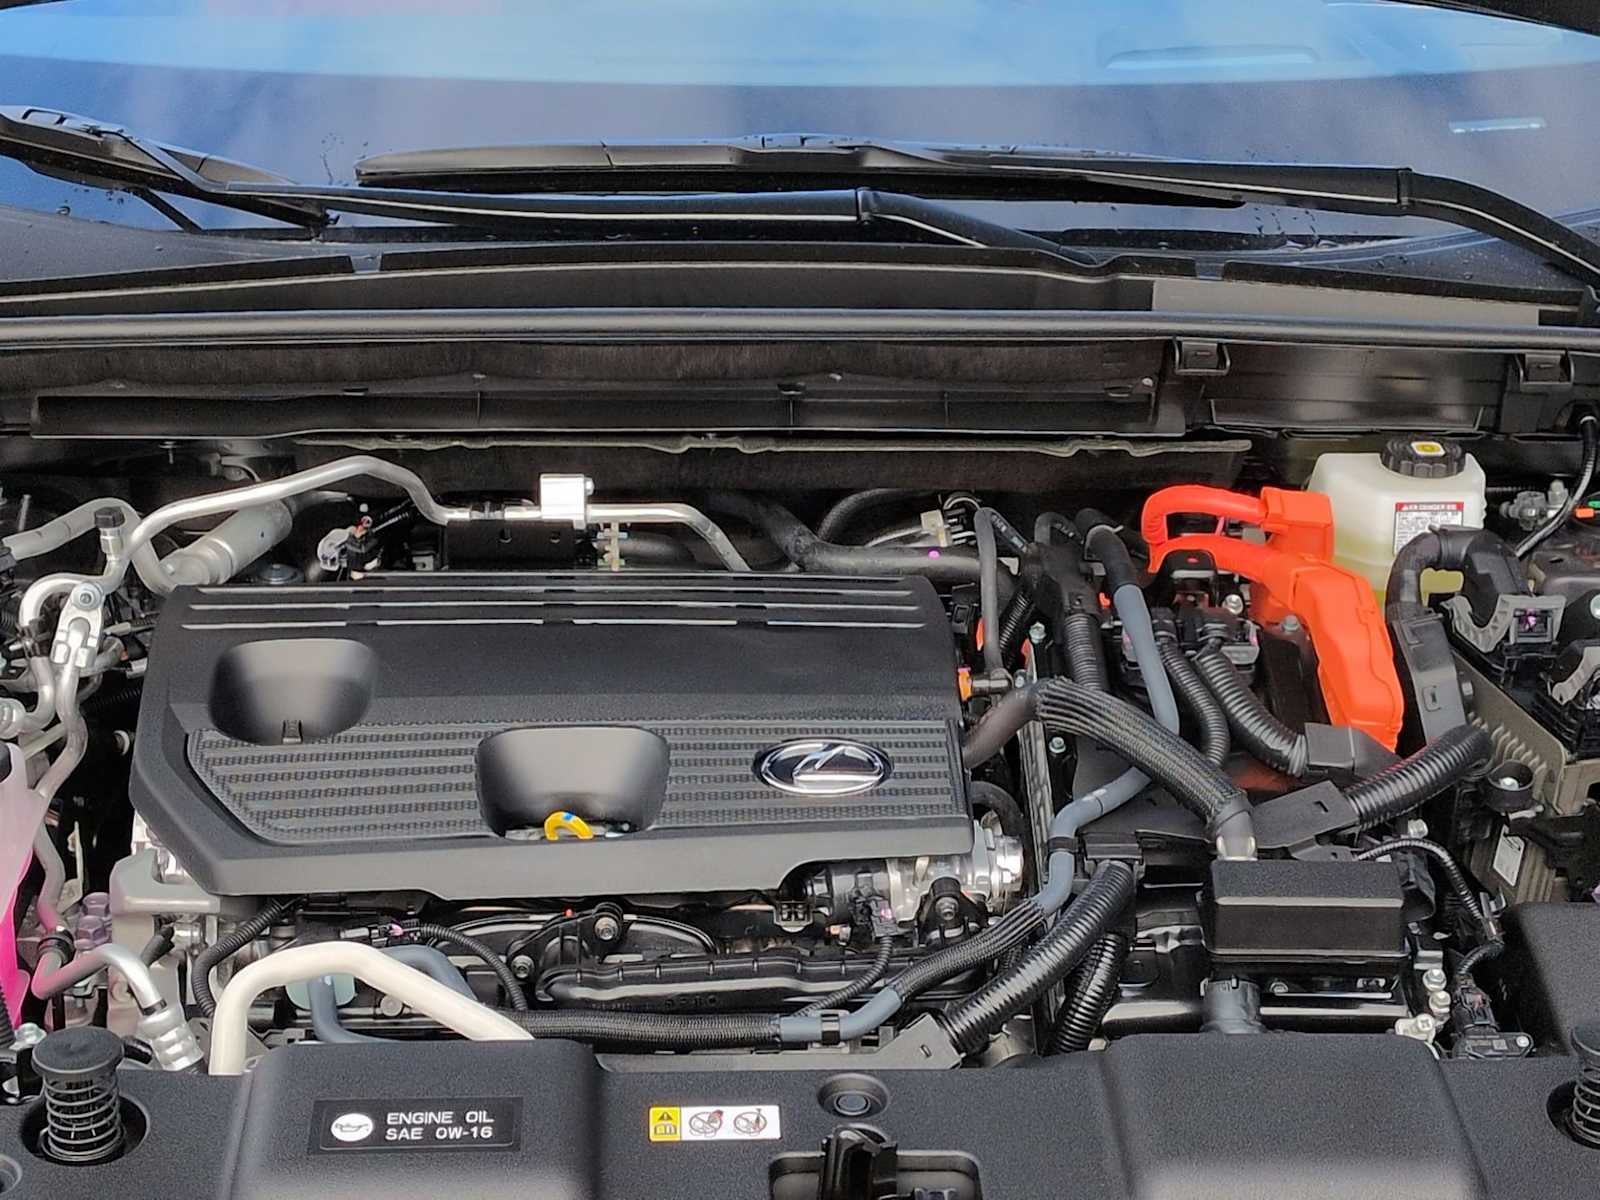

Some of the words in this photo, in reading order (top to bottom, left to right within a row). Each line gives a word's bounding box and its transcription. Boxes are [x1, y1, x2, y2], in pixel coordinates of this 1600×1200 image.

[386, 1111, 454, 1125] ENGINE
[465, 1110, 494, 1123] OIL
[385, 1127, 424, 1141] SAE
[435, 1126, 493, 1140] 0W-16
